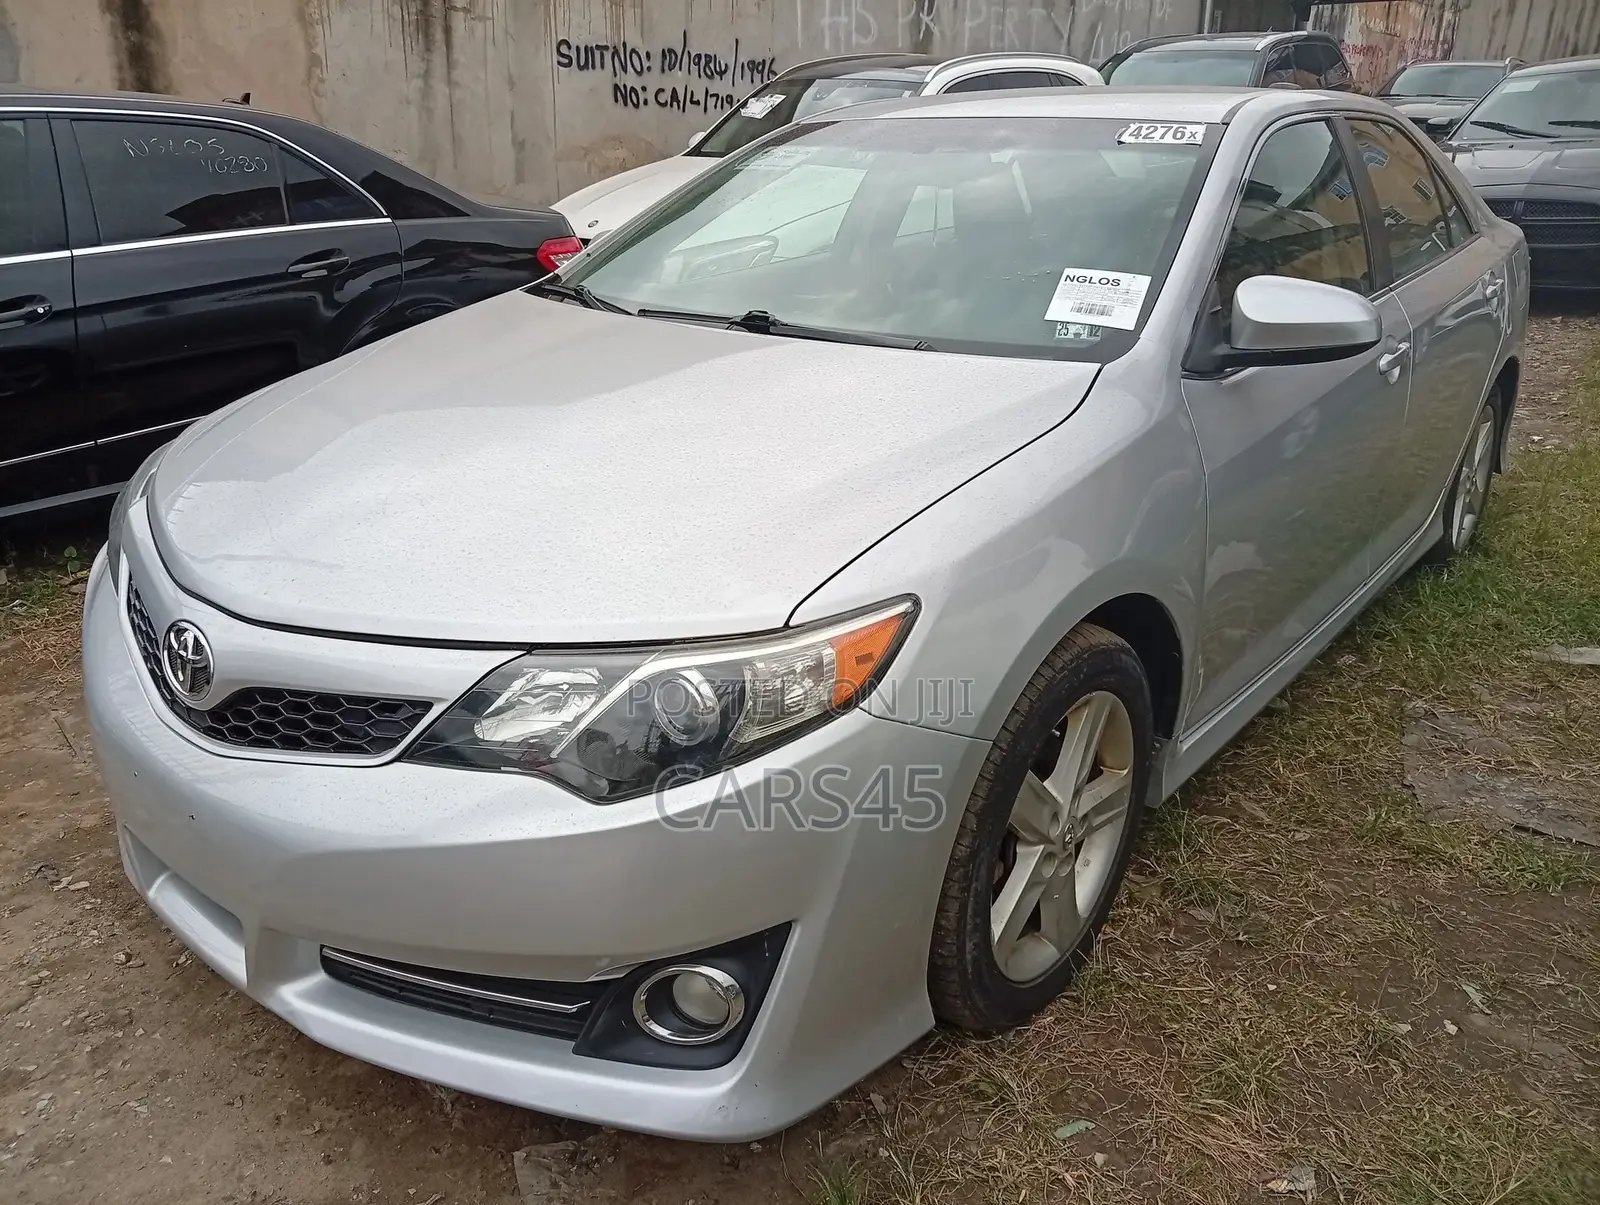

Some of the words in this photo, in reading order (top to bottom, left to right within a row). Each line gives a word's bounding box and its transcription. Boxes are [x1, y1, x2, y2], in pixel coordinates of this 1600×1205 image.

[613, 82, 649, 109] NO:
[654, 84, 741, 114] CA/L/719
[1064, 274, 1121, 287] NGLOS
